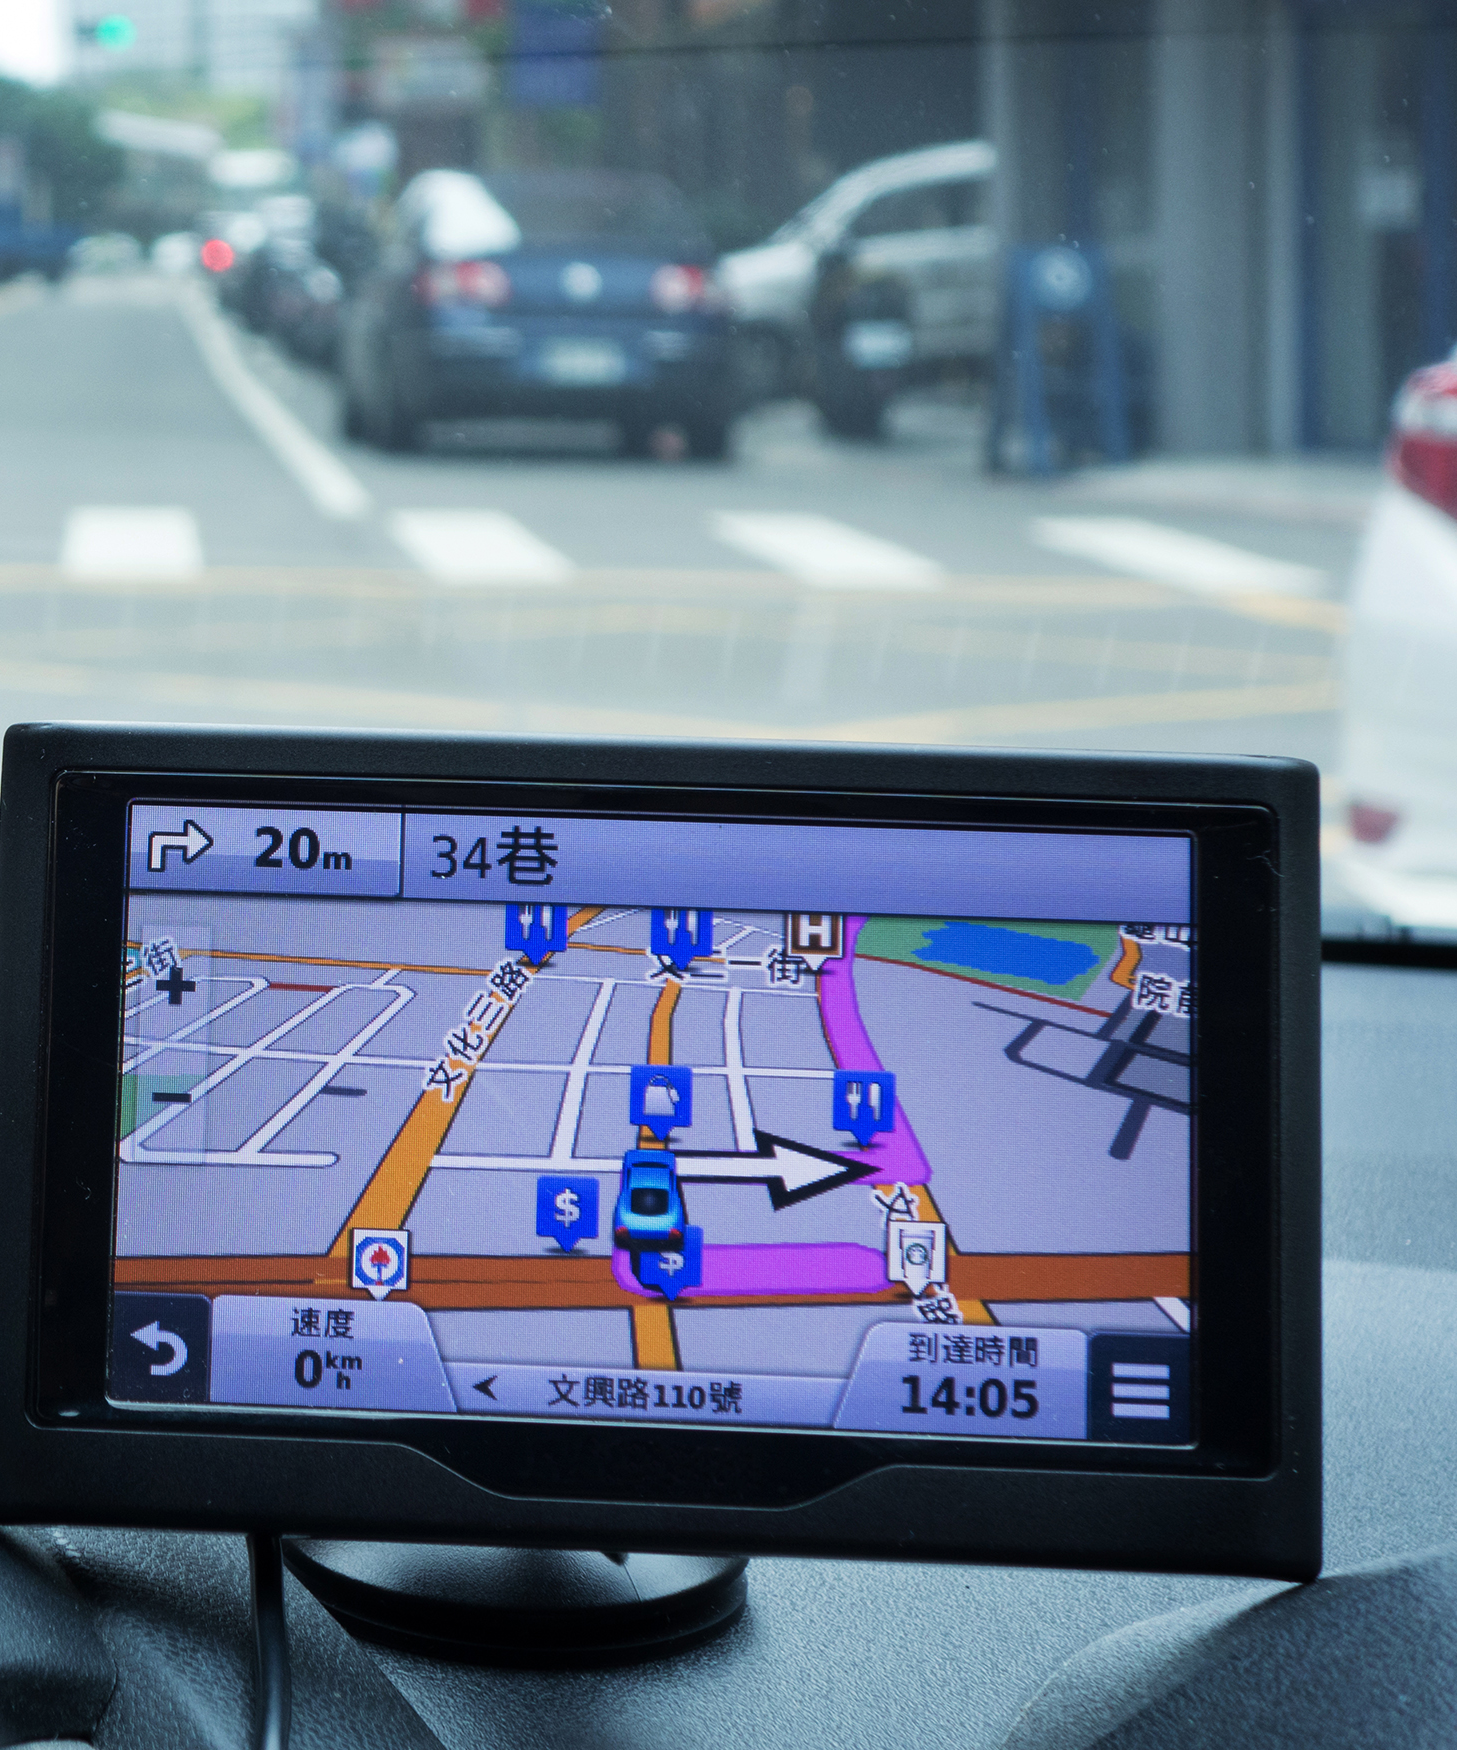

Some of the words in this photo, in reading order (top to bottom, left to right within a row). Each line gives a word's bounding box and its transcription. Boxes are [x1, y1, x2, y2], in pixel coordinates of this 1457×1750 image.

[430, 825, 559, 886] 34巷
[427, 961, 530, 1100] 文化三路
[290, 1307, 355, 1339] 速度
[909, 1331, 1038, 1368] 到達時間
[548, 1373, 743, 1414] 文興路110號
[901, 1374, 1040, 1420] 14:05
